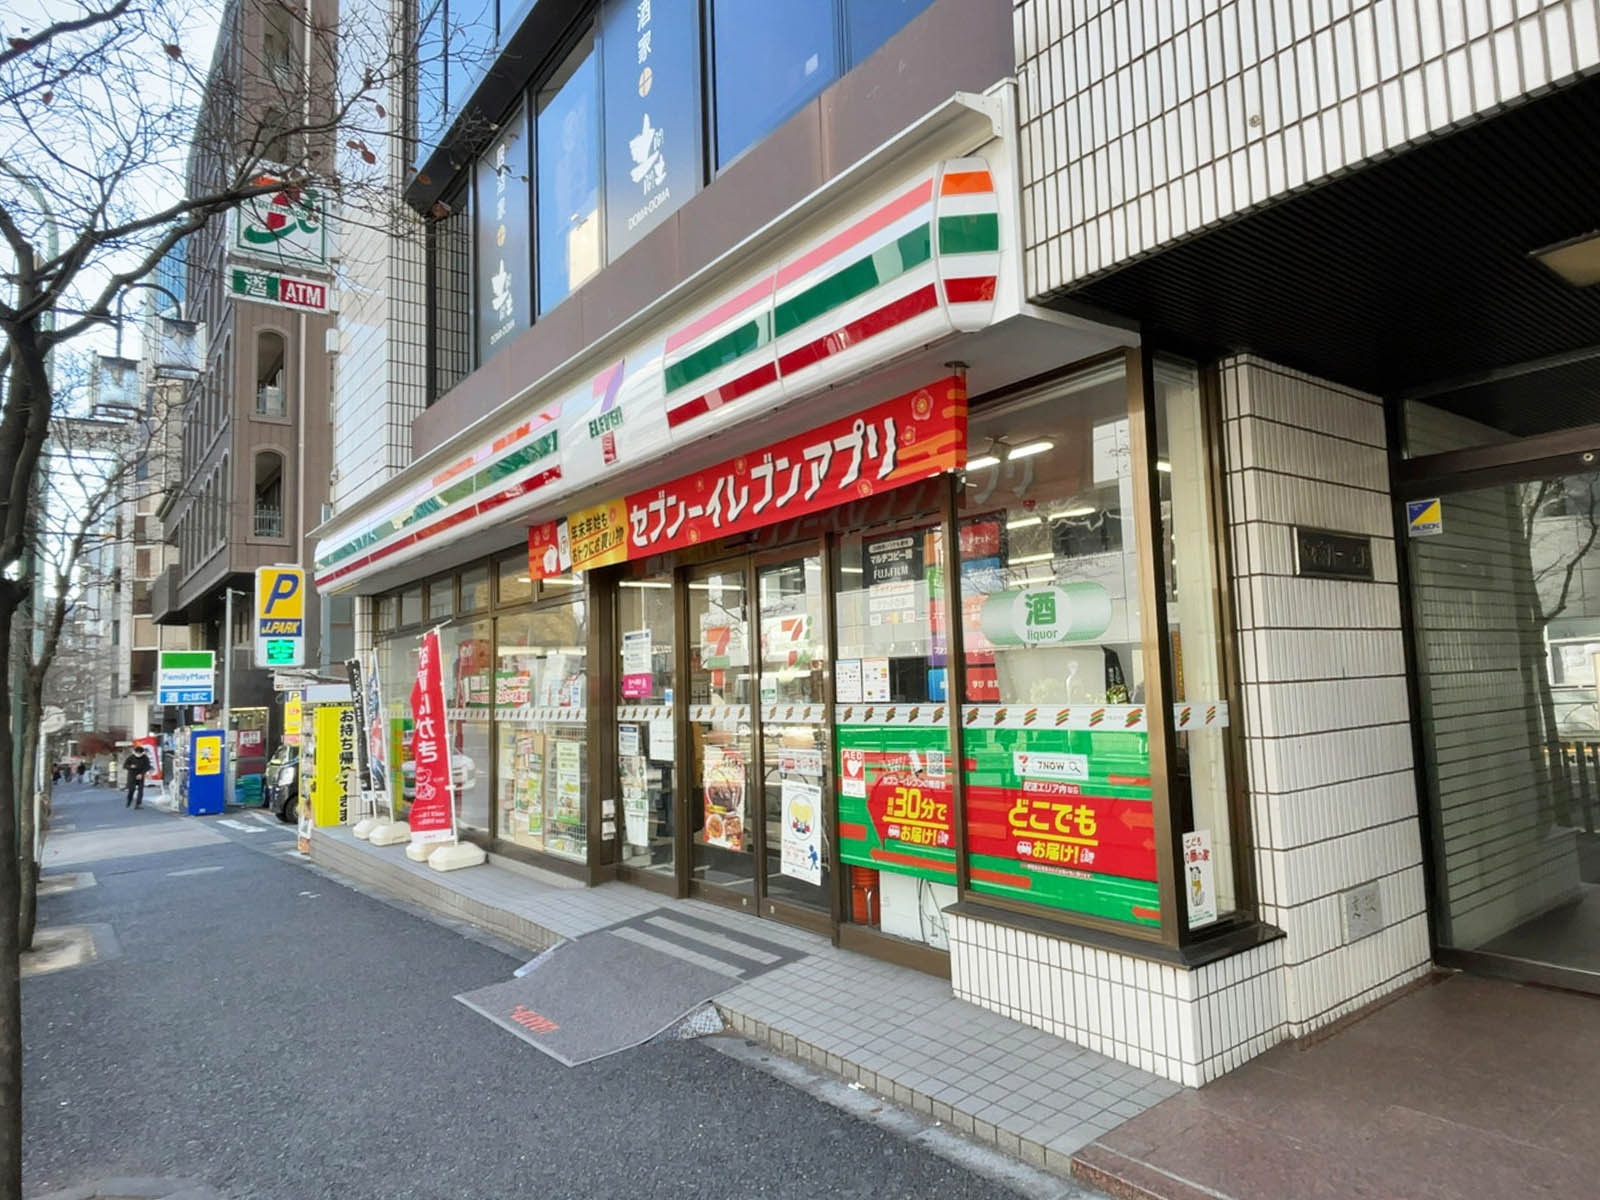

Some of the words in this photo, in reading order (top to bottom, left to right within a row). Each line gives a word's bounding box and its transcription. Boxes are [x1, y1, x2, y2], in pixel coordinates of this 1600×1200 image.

[285, 281, 321, 306] ATM
[873, 564, 909, 580] FUJIFILM
[264, 573, 299, 614] P
[1024, 591, 1057, 626] 酒
[261, 621, 300, 634] J.PARK
[1027, 630, 1059, 641] liquor
[162, 671, 211, 683] FamilyMart
[842, 751, 864, 761] AED
[1037, 761, 1065, 770] 7NOW
[1008, 798, 1097, 836] どこでも
